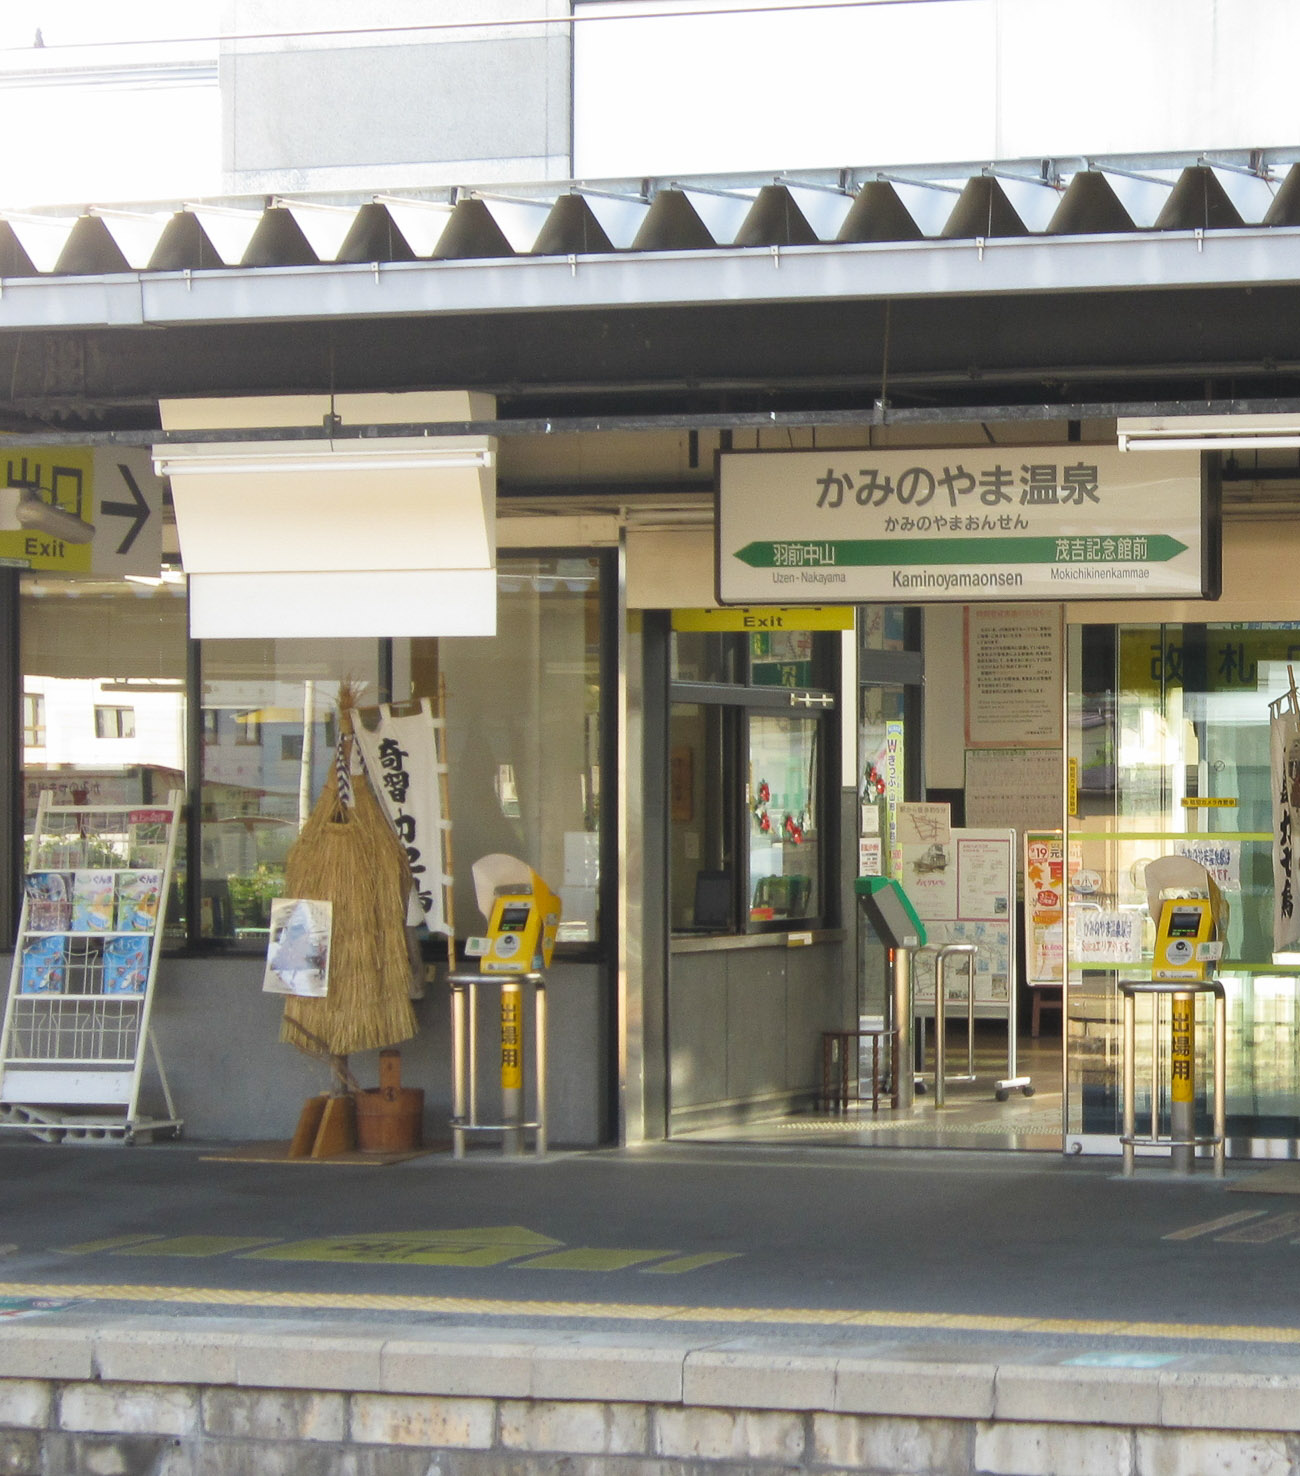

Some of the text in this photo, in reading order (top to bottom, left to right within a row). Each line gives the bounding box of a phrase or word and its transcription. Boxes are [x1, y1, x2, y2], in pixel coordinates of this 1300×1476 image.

[815, 461, 1101, 509] かみのやま温泉
[884, 513, 1029, 532] かみのやまおんせん
[25, 537, 65, 558] Exit
[773, 543, 836, 566] 羽前中山
[1055, 537, 1149, 561] 茂吉記念館前
[892, 570, 1024, 591] Kaminoyamaonsen
[1050, 567, 1150, 580] Mokichikinenkammae
[743, 616, 784, 627] Exit
[501, 1003, 518, 1068] 出場用
[1172, 1012, 1190, 1082] 出場用
